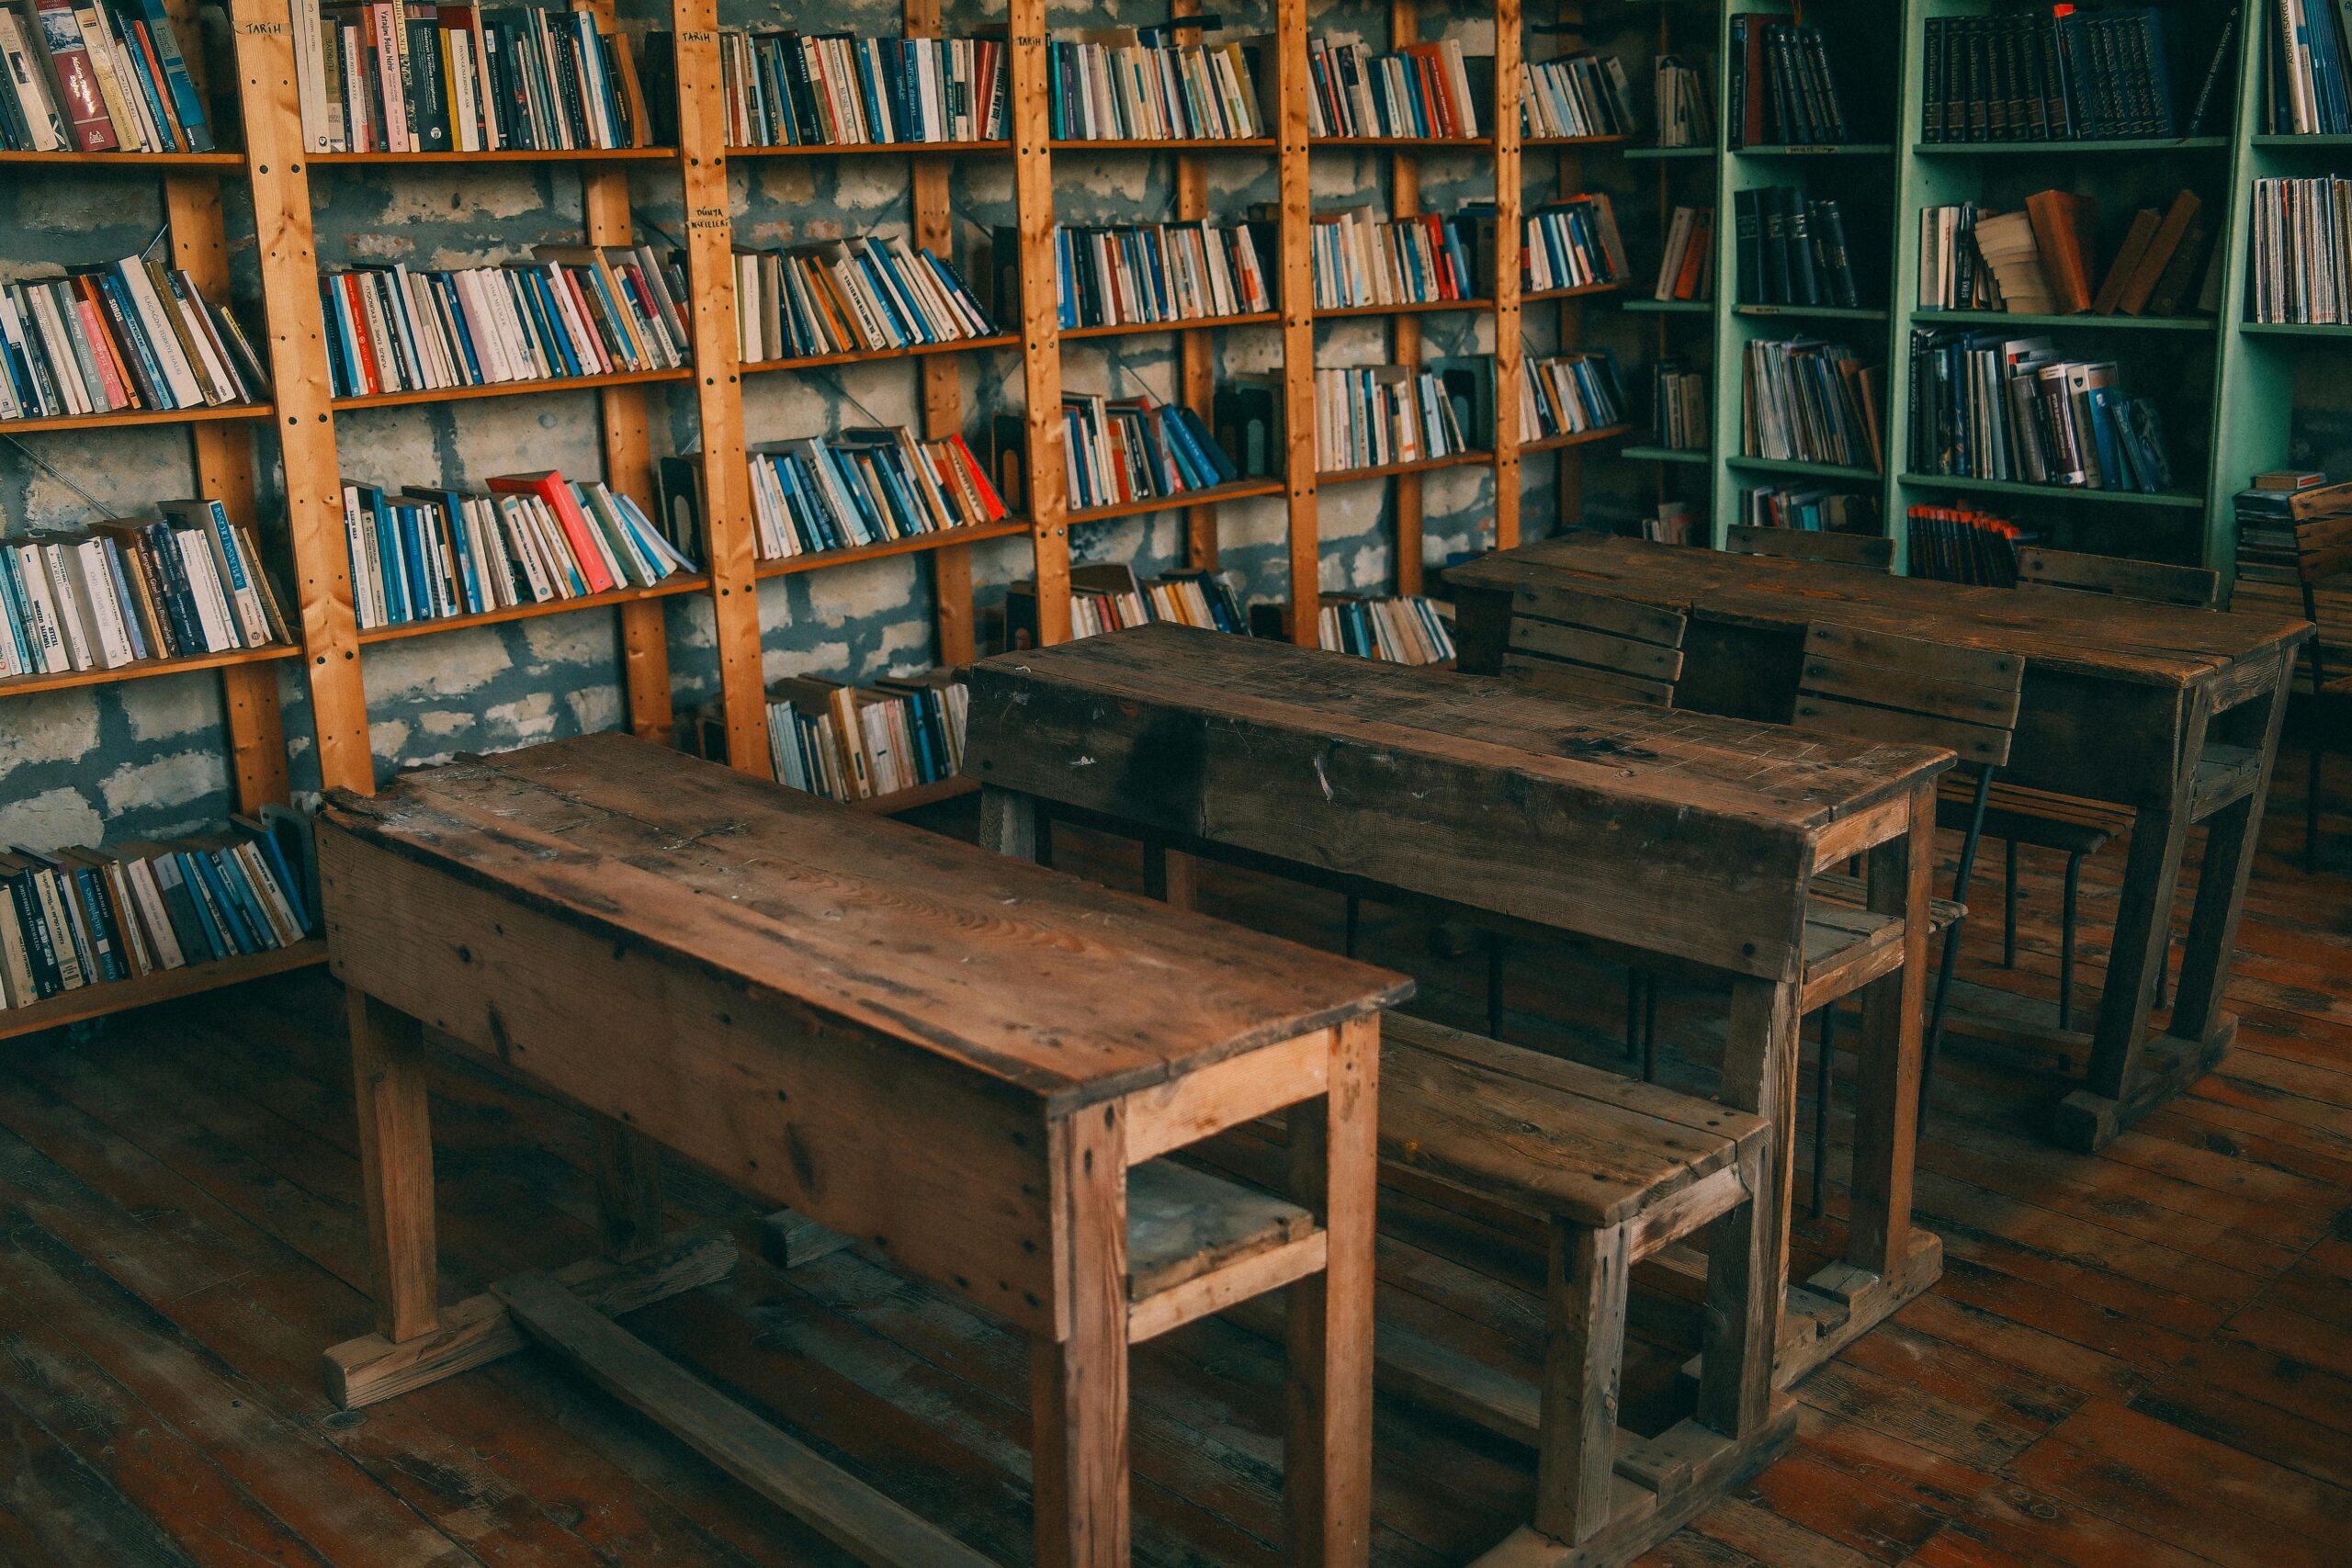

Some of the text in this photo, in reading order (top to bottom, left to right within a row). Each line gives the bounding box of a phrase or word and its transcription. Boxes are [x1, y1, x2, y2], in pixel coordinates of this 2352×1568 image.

[2285, 31, 2293, 64] ADNAN
[109, 298, 124, 323] SOROS
[379, 347, 387, 368] YUNUS
[48, 626, 58, 647] TEZLER
[83, 886, 104, 938] Catchphrases
[102, 953, 116, 980] Oxford
